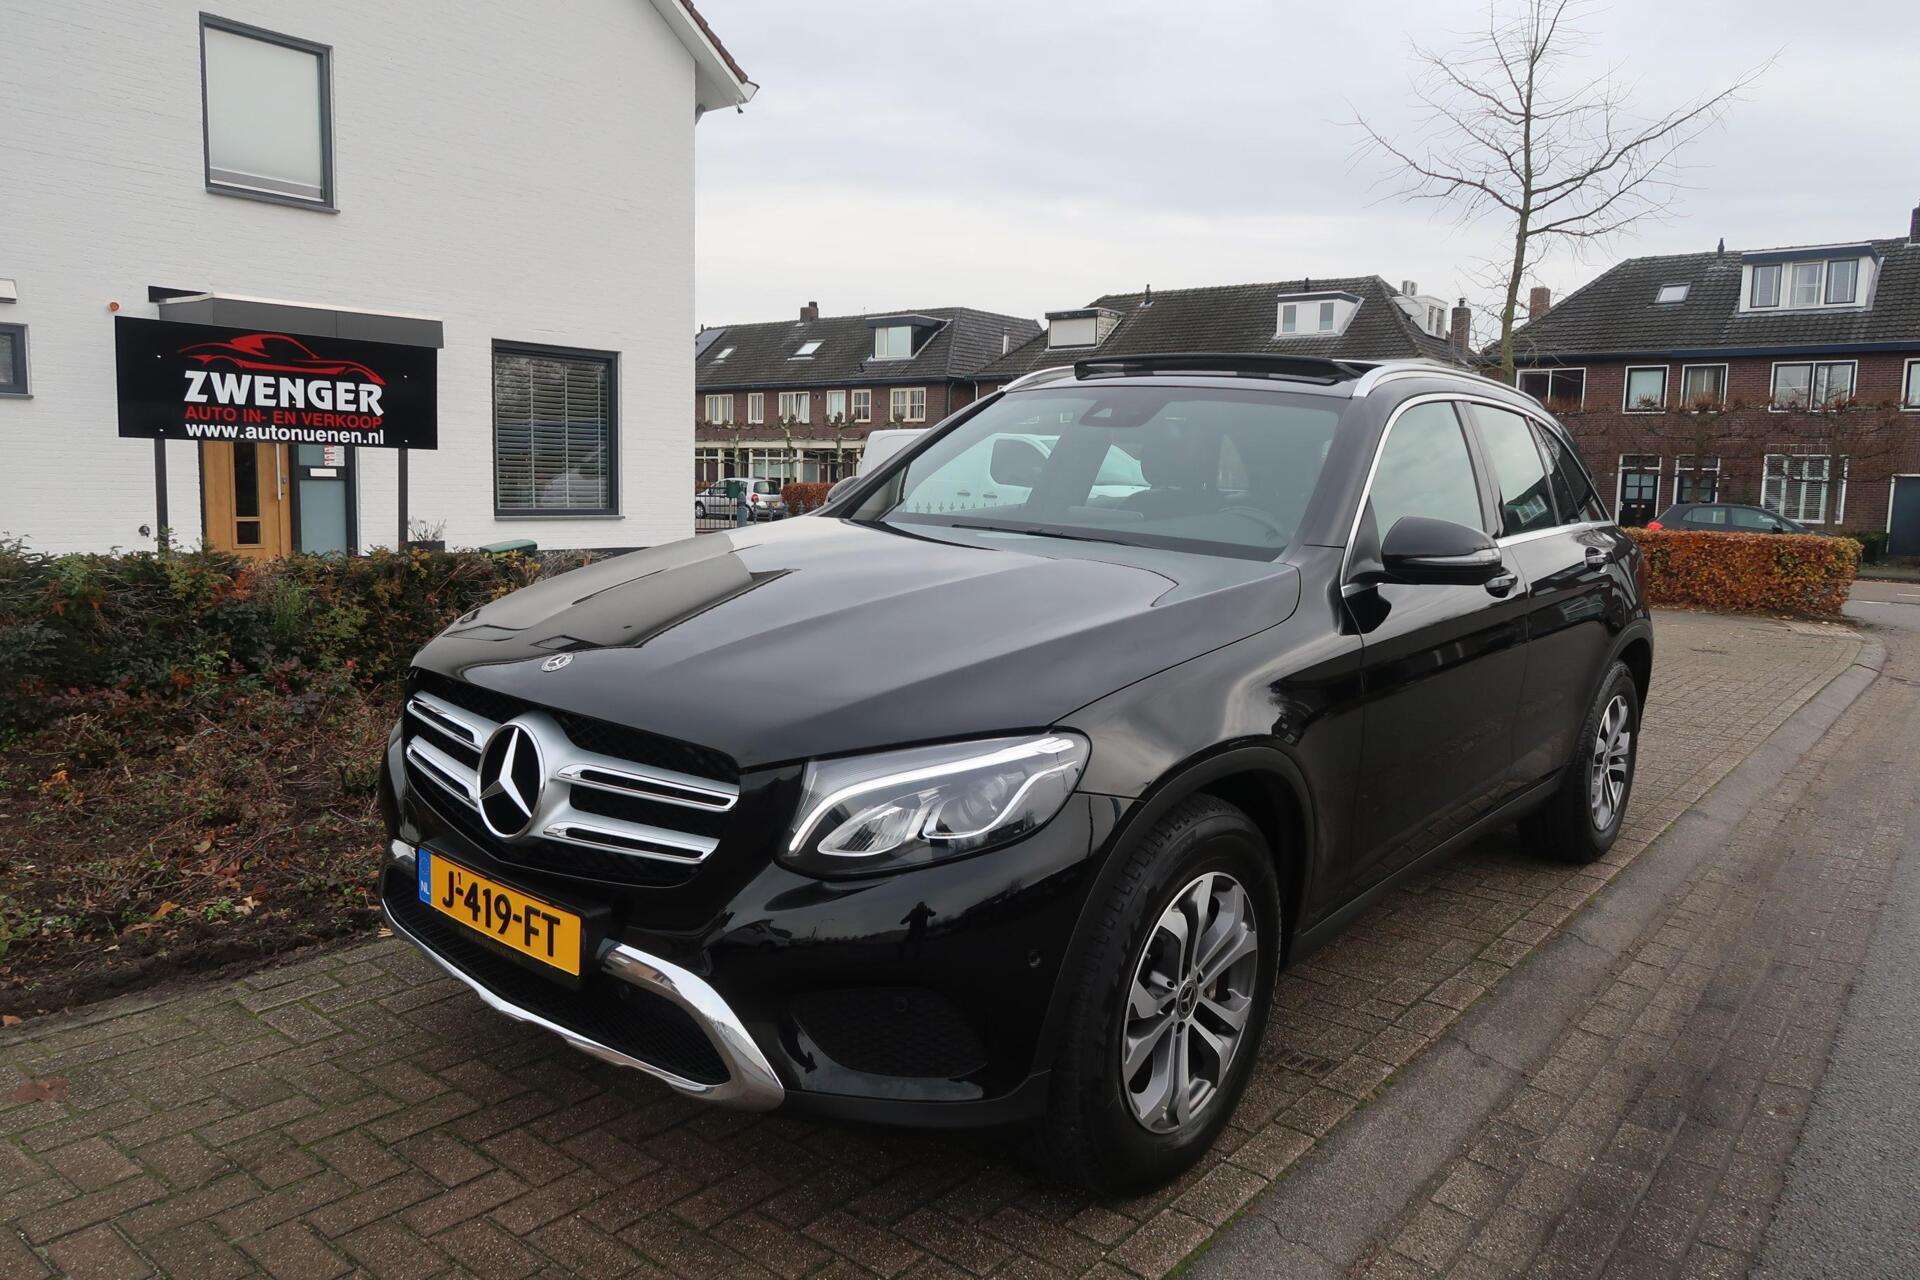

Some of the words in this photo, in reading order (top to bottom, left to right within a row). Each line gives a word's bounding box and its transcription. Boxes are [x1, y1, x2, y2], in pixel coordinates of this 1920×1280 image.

[184, 370, 385, 416] ZWENGER
[185, 405, 237, 422] AUTO
[243, 408, 267, 423] IN-
[273, 411, 297, 425] EN
[299, 412, 383, 429] VERKOOP
[185, 423, 385, 445] www.autonuenen.nl
[420, 880, 430, 895] NL
[441, 870, 561, 958] J-419-FT
